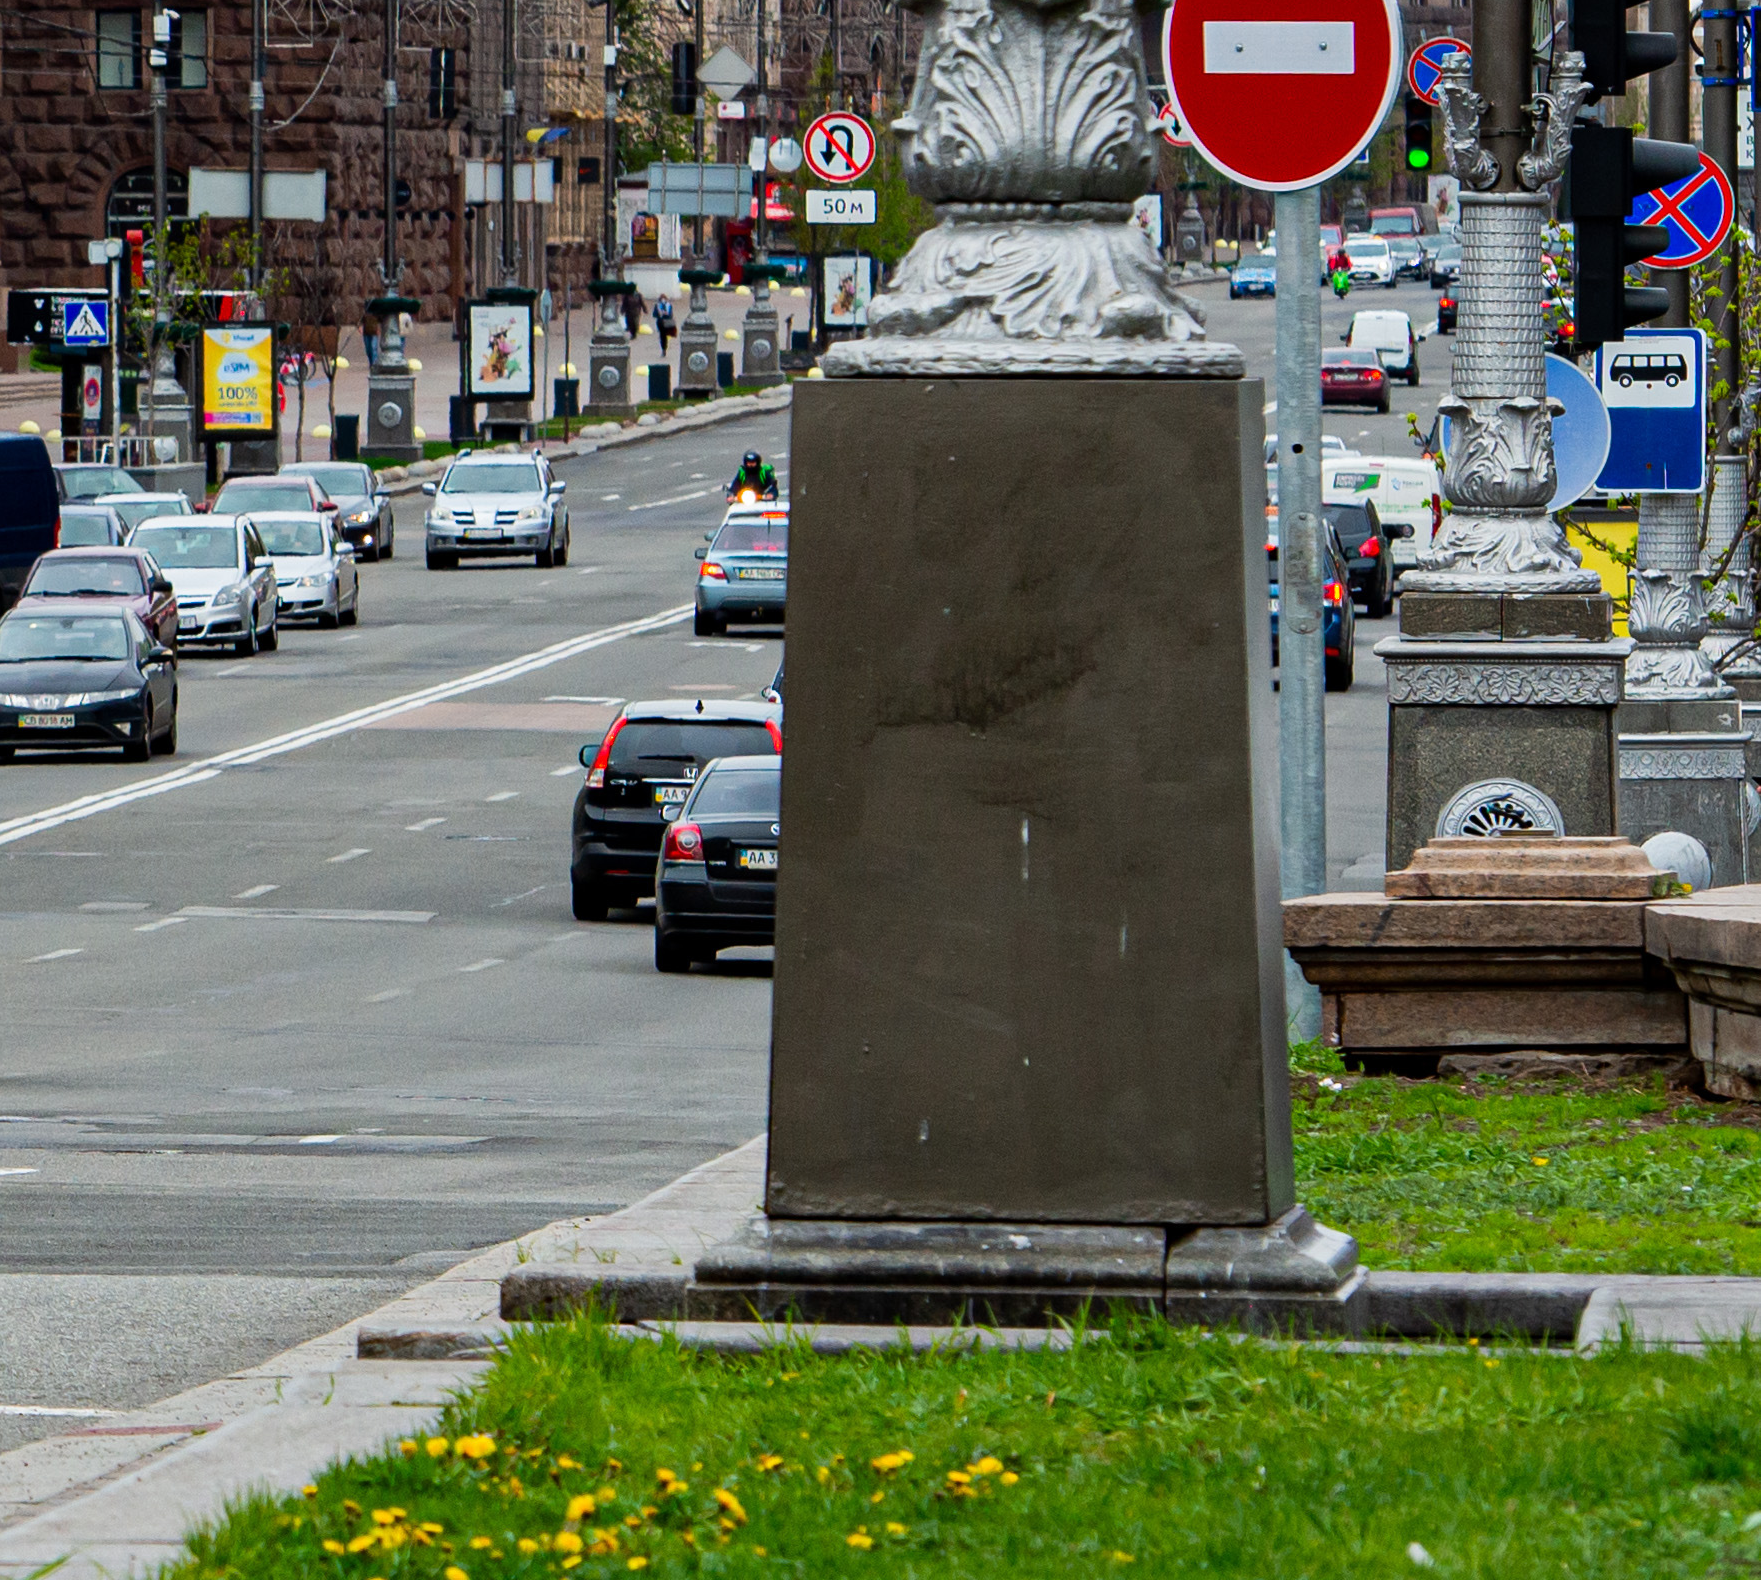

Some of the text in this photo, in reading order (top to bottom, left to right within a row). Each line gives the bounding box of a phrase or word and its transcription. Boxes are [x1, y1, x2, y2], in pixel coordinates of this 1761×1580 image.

[823, 199, 846, 214] 50
[218, 387, 258, 400] 100%
[663, 789, 674, 800] AA
[749, 852, 776, 864] AA 3
